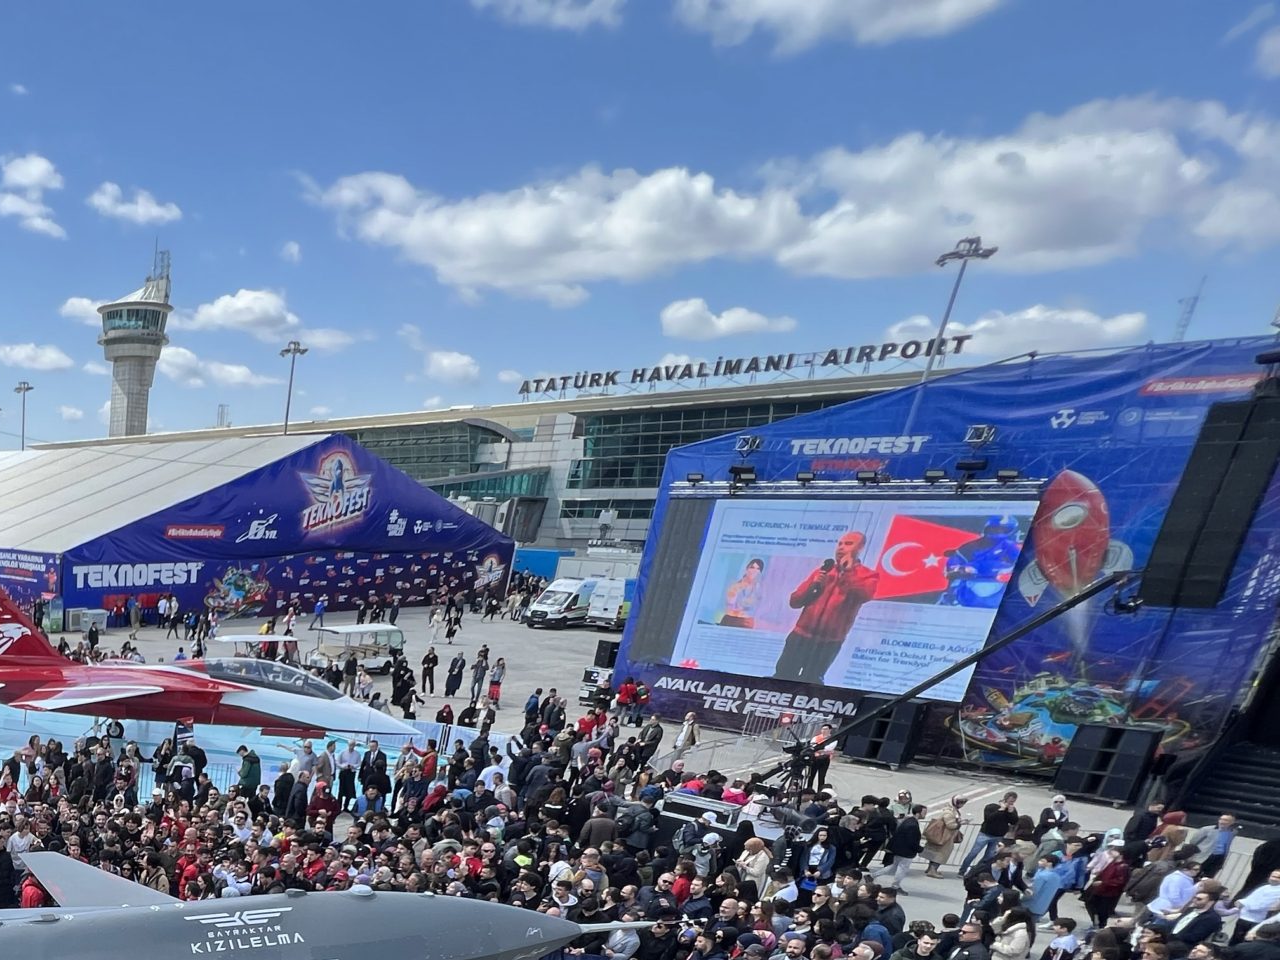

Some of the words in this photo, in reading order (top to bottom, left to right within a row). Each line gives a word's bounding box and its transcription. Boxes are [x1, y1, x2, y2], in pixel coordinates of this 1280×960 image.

[518, 370, 621, 394] ATATÜRK
[630, 353, 795, 383] HAVALİMANI
[821, 335, 973, 367] AIRPORT
[791, 436, 932, 456] TEKNOFEST
[303, 487, 371, 530] TEKNOFEST
[73, 562, 204, 589] TEKNOFEST
[654, 676, 740, 699] AYAKLARI
[744, 687, 792, 706] YERE
[703, 696, 743, 714] TEK
[190, 932, 305, 954] KIZILELMA
[207, 925, 282, 938] BAYRAKTAR
